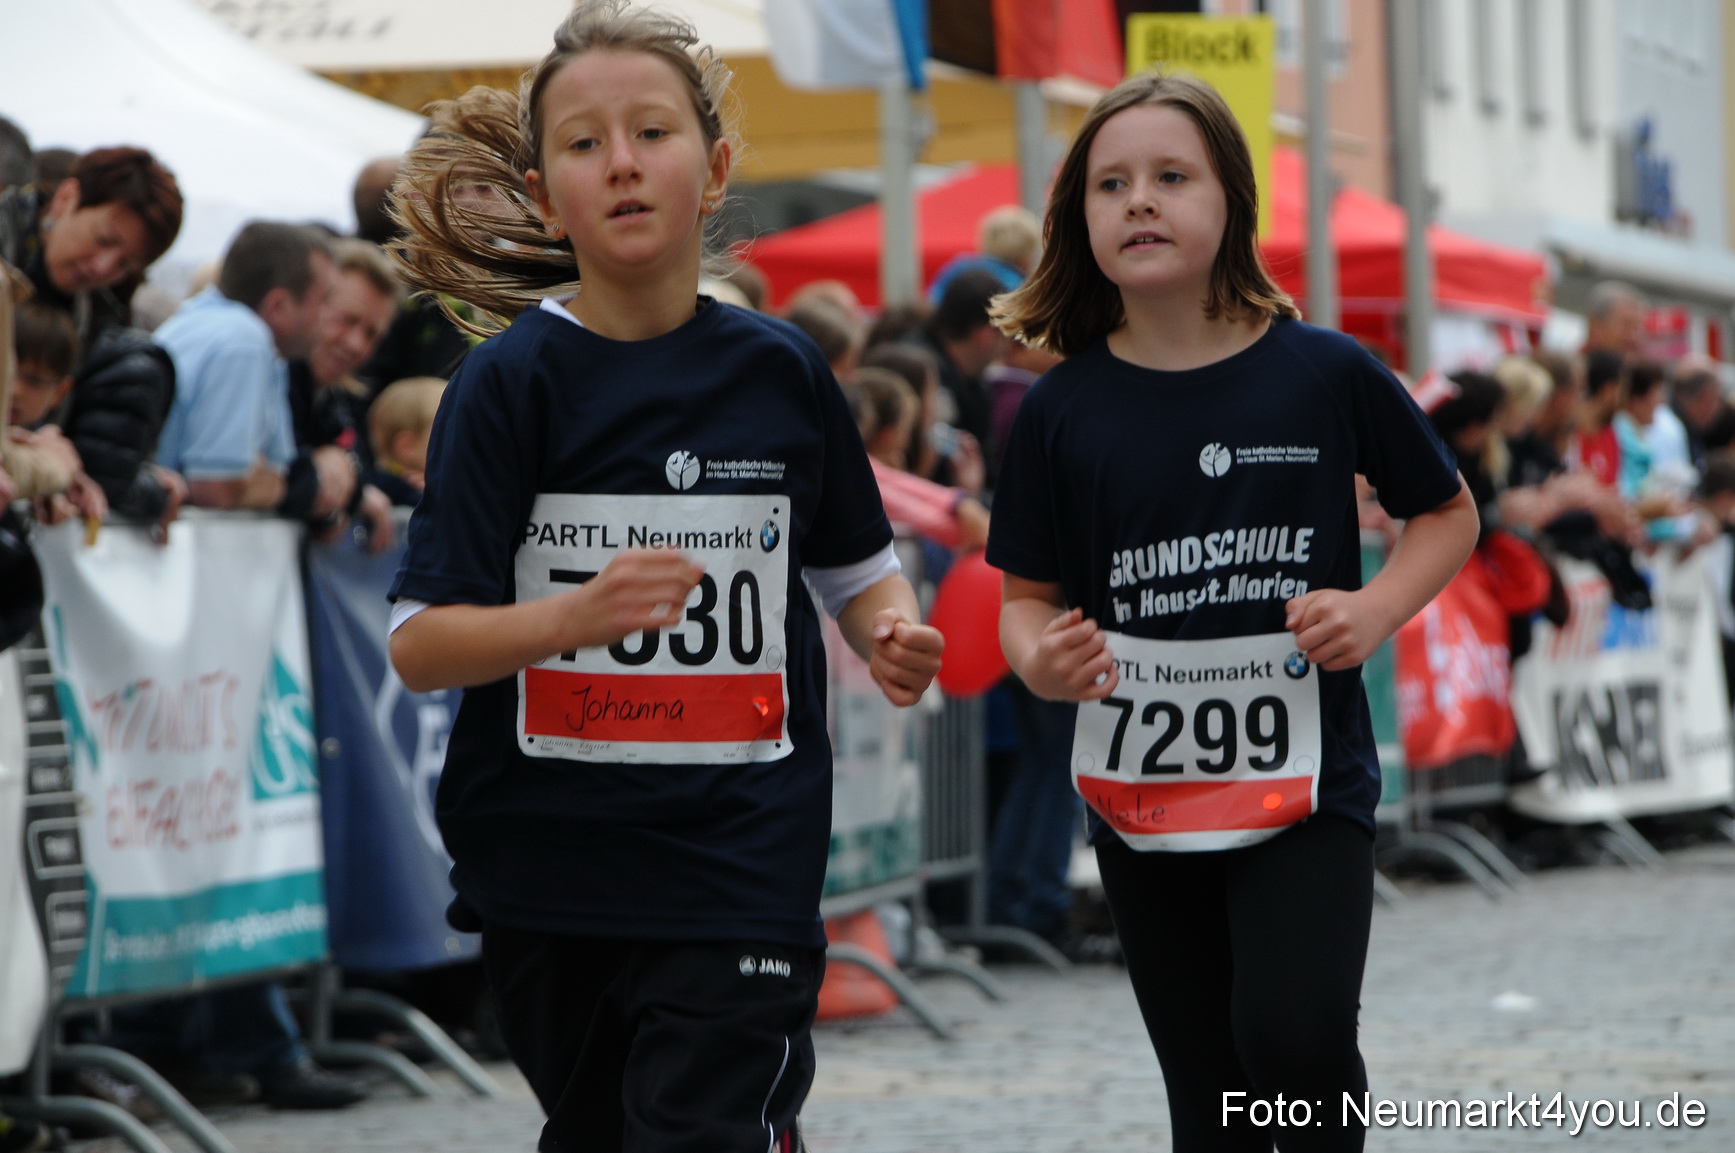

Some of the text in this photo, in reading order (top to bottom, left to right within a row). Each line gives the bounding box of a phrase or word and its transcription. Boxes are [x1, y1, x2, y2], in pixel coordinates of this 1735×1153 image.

[1146, 25, 1261, 66] Block
[1252, 446, 1286, 455] katholische
[522, 522, 619, 549] PARTL
[627, 524, 753, 550] Neumarkt
[1109, 525, 1314, 588] GRUNDSCHULE
[1112, 596, 1132, 624] in
[1140, 587, 1198, 618] Haus
[1155, 660, 1273, 685] Neumarkt
[565, 684, 684, 733] Johanna
[1100, 694, 1290, 776] 7299
[759, 957, 791, 978] JAKO
